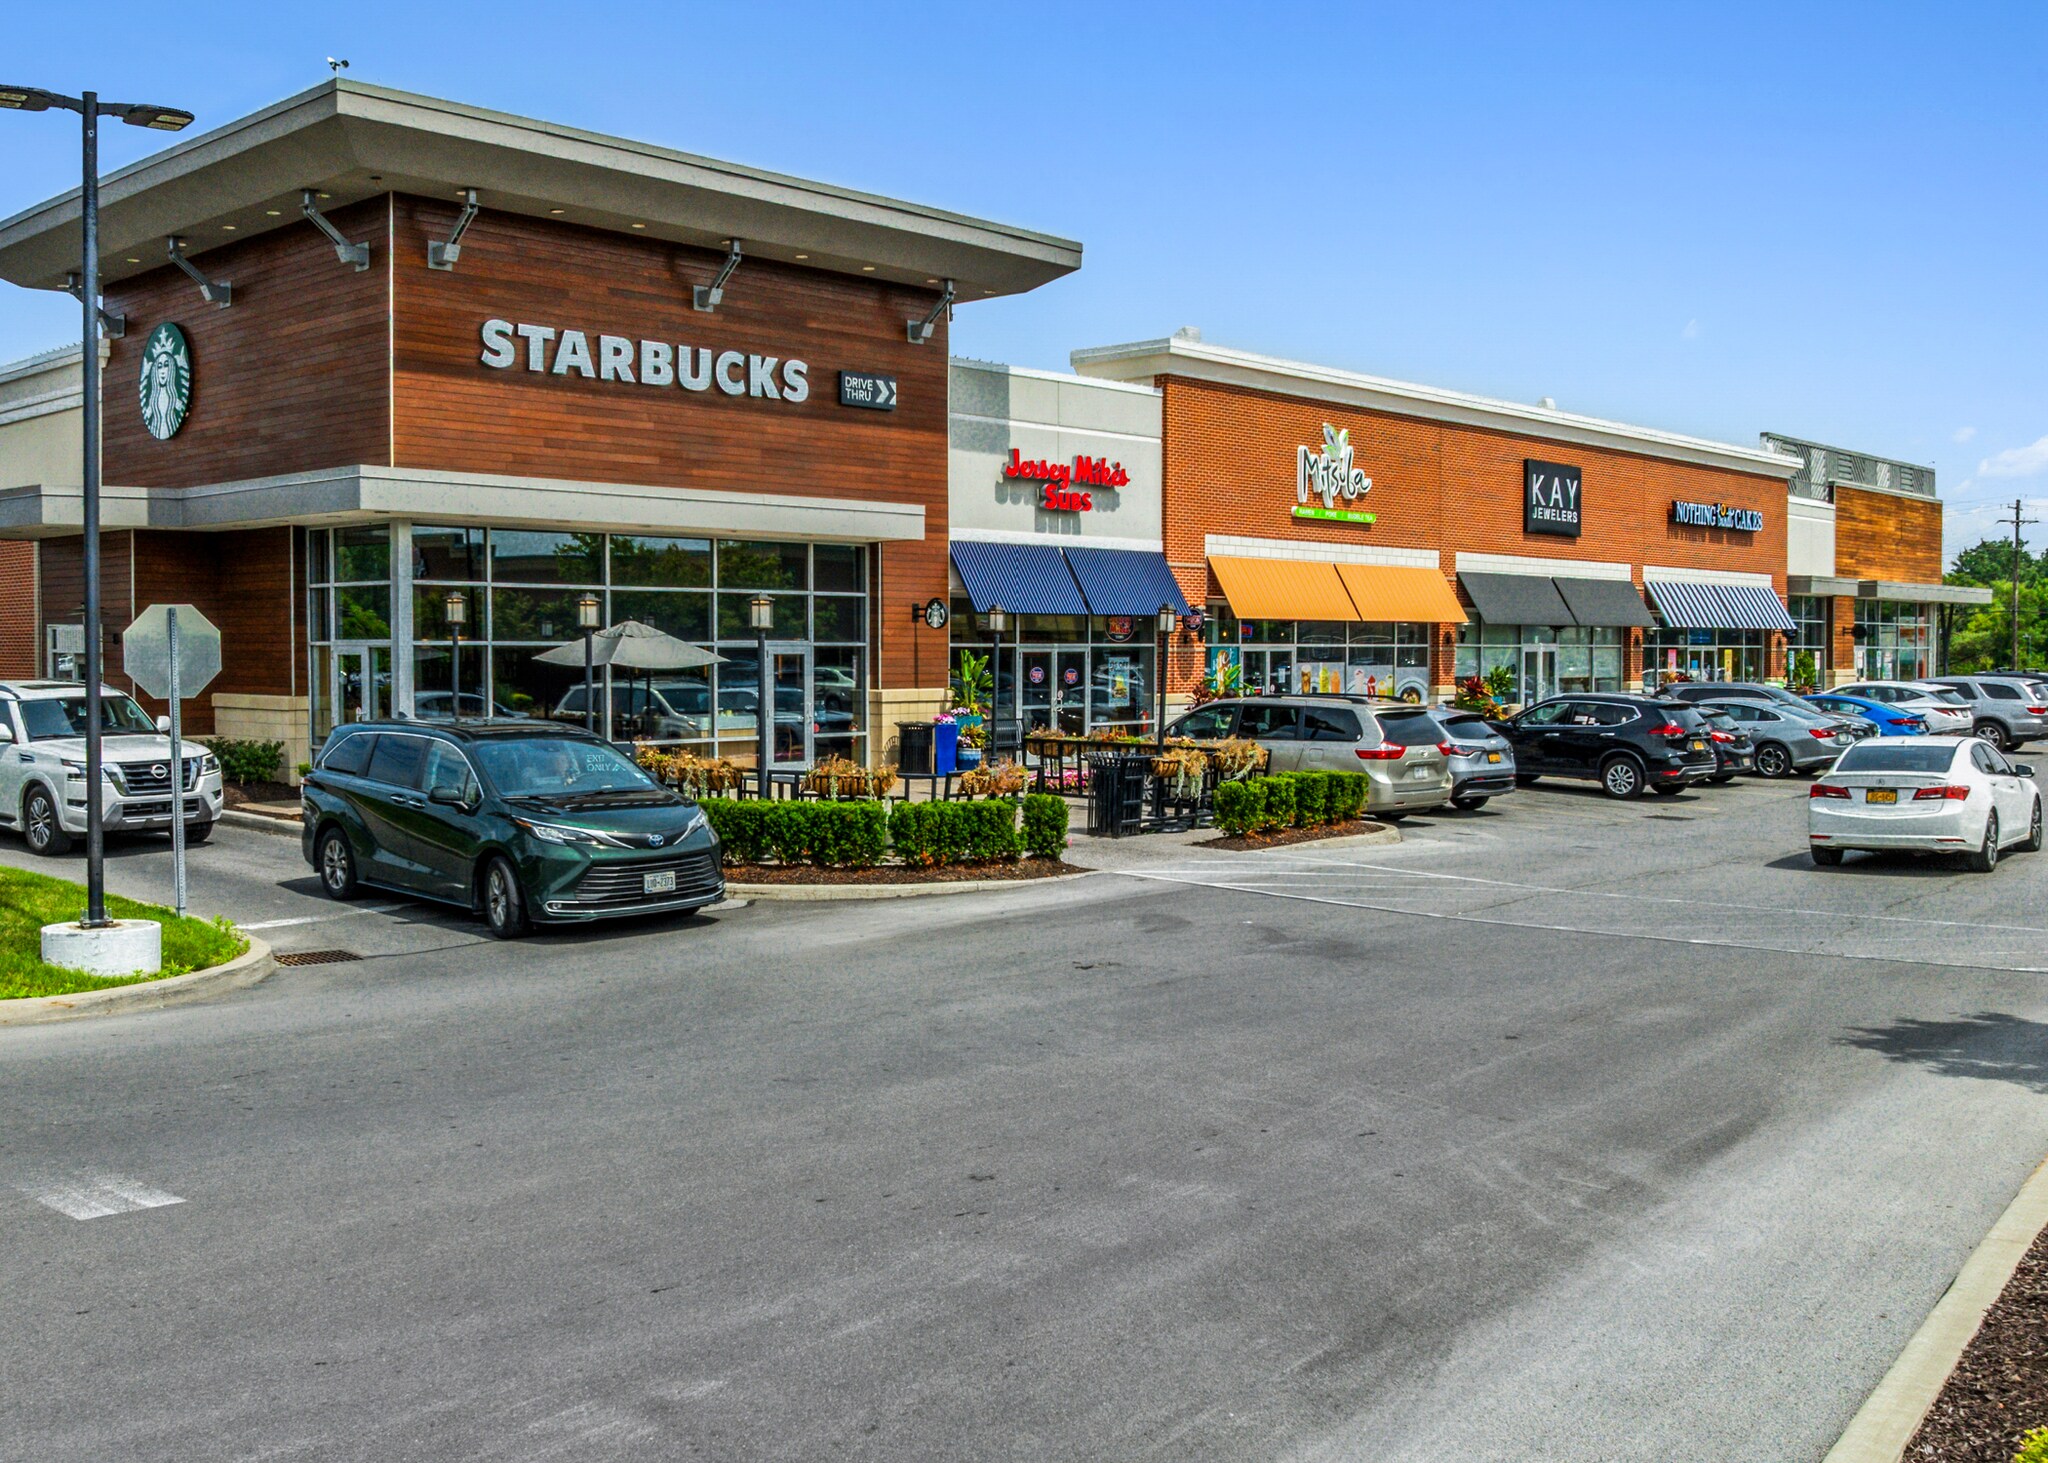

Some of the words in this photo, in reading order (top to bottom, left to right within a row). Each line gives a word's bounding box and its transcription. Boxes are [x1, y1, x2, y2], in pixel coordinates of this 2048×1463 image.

[481, 318, 810, 403] STARBUCKS
[845, 376, 873, 391] DRIVE
[845, 388, 872, 402] THRU
[1005, 448, 1070, 490] Jersey
[1298, 445, 1372, 508] Mitsuba
[1532, 473, 1578, 510] KAY
[1533, 507, 1578, 524] JEWELERS
[1676, 501, 1716, 526] NOTHING
[1735, 509, 1763, 531] CAKES
[586, 754, 605, 763] EXIT
[586, 763, 611, 772] ONLY
